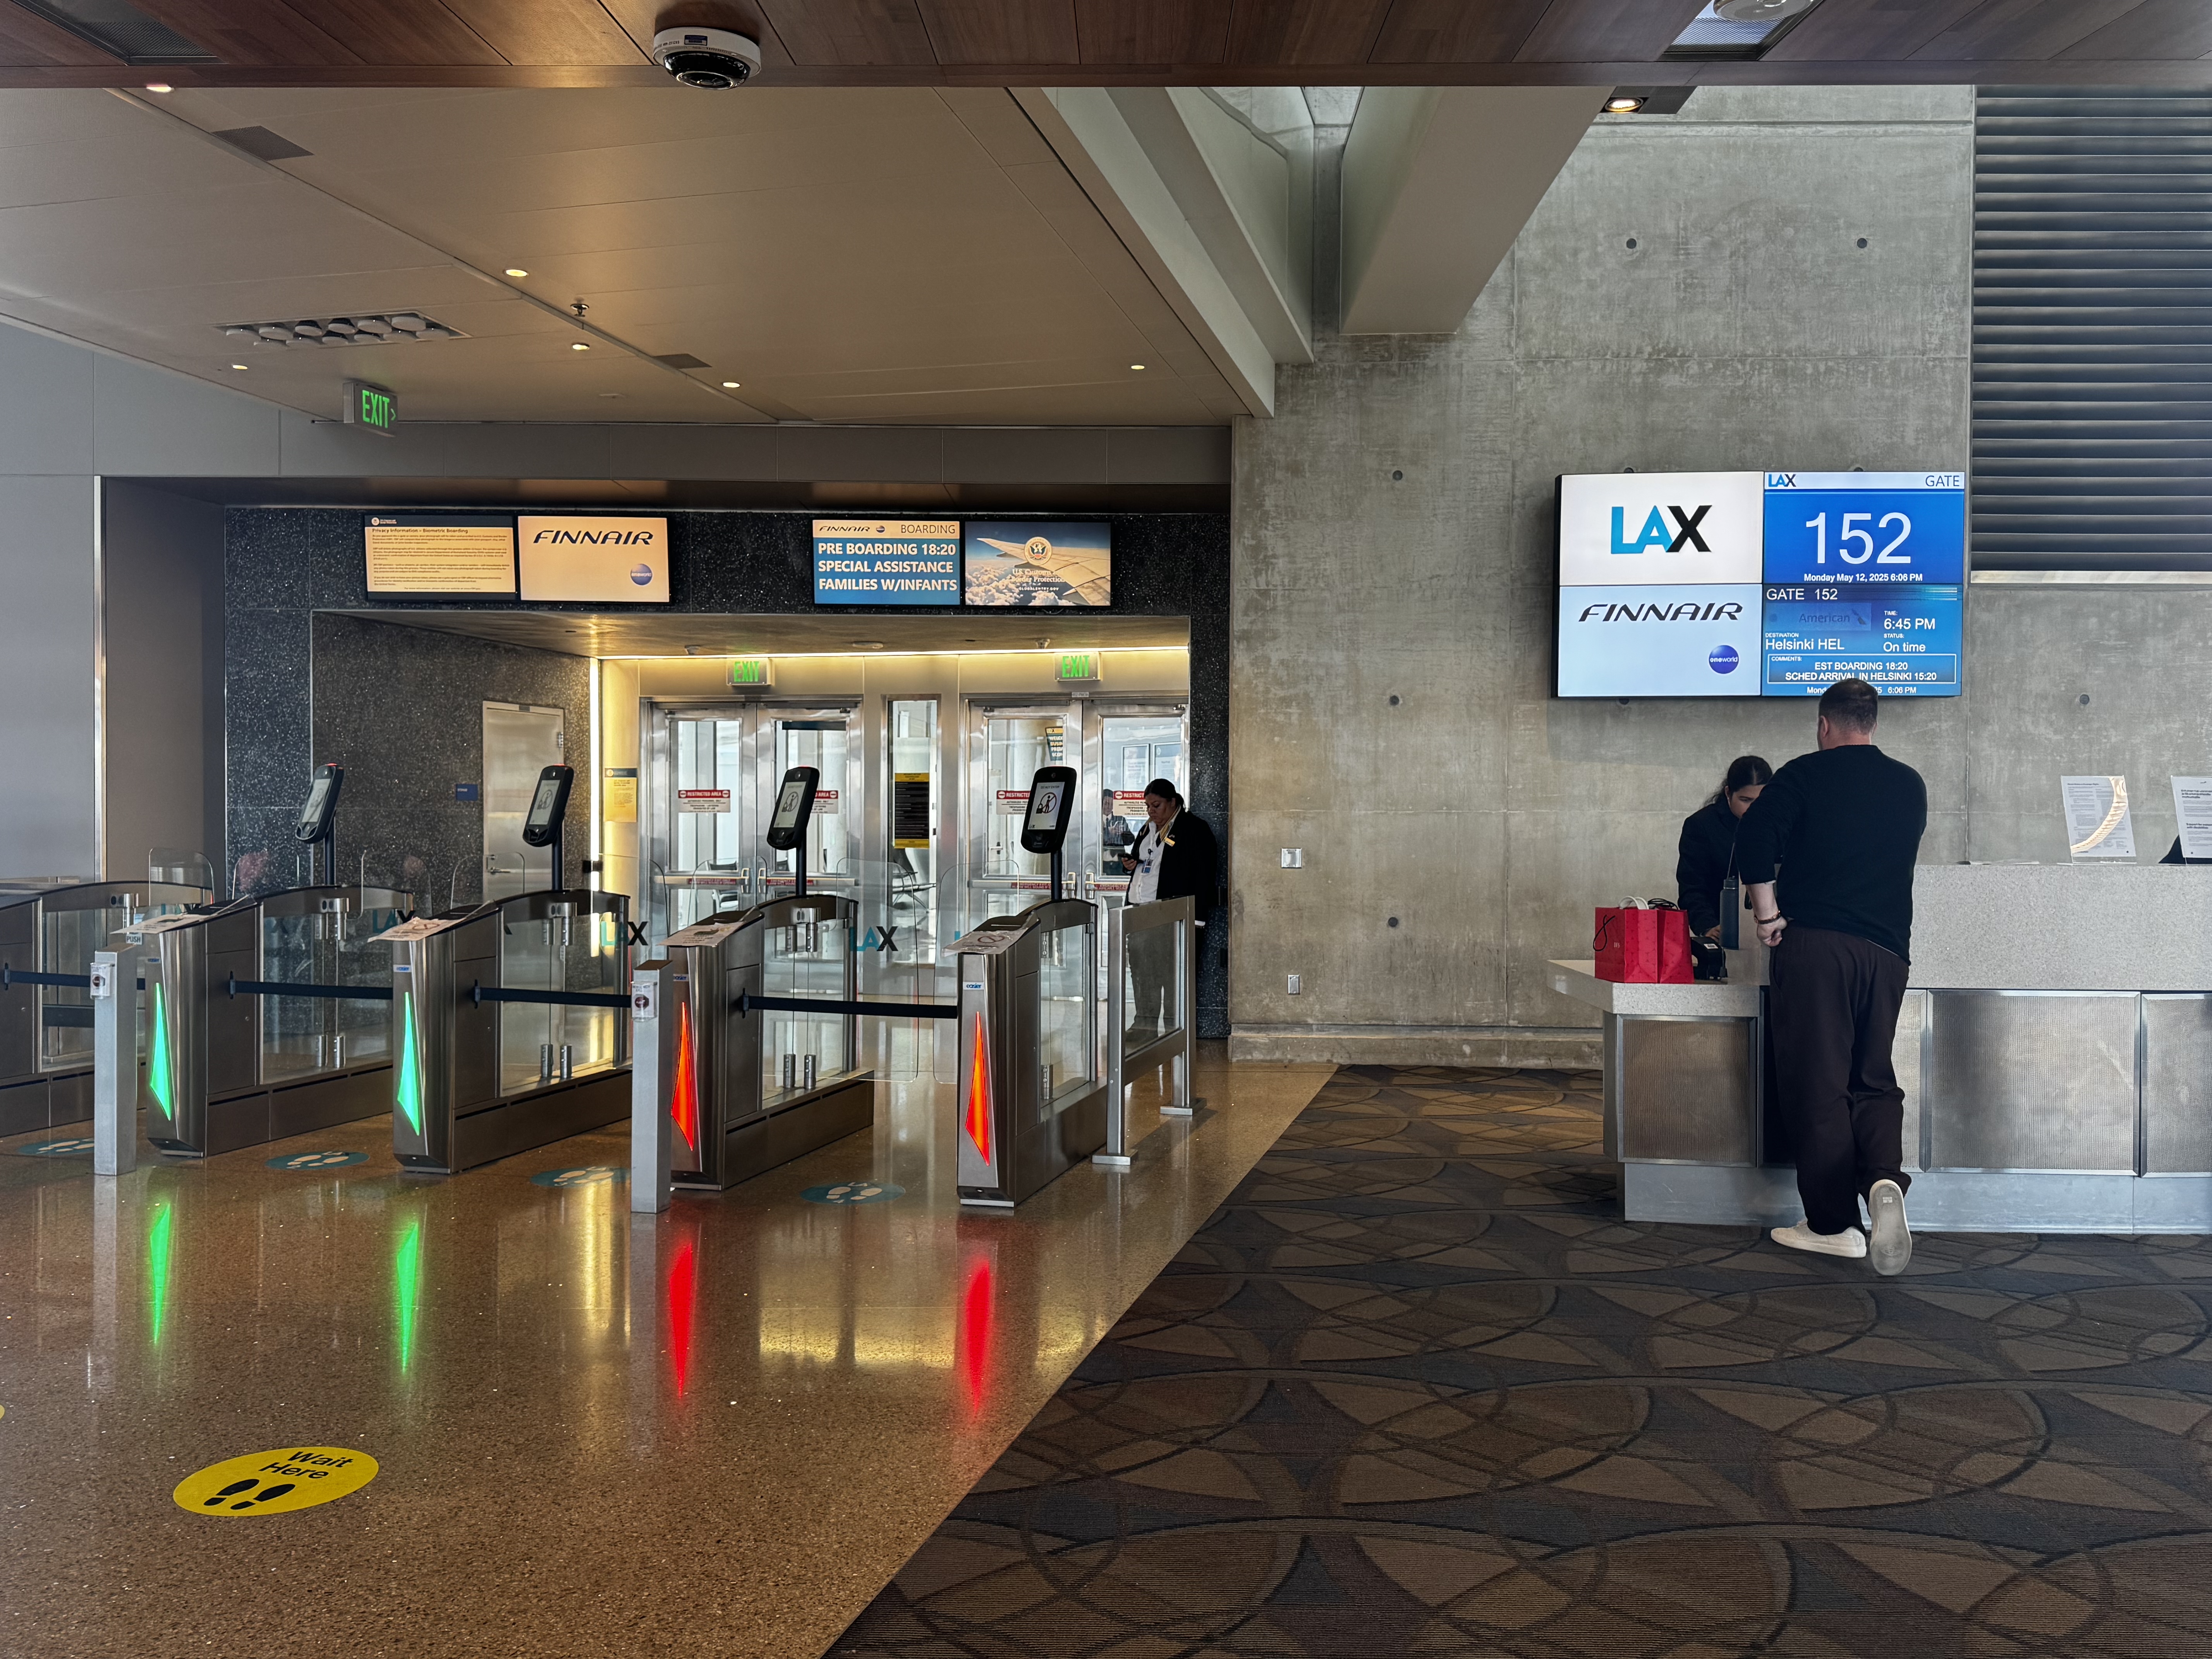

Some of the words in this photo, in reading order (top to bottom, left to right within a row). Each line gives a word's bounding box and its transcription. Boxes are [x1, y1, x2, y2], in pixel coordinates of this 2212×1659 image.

[362, 390, 390, 428] EXIT
[1768, 474, 1796, 487] LAX
[1925, 475, 1960, 487] GATE
[901, 525, 955, 534] BOARDING
[1611, 505, 1712, 554] LAX
[533, 530, 653, 545] FINNAIR
[1806, 512, 1911, 564] 152
[818, 543, 843, 554] PRE
[846, 543, 918, 555] BOARDING
[922, 544, 956, 555] 18:20
[818, 560, 871, 572] SPECIAL
[874, 561, 953, 573] ASSISTANCE
[1804, 574, 1835, 582] Monday
[1837, 574, 1853, 582] May
[1856, 574, 1867, 582] 12,
[819, 579, 878, 590] FAMILIES
[881, 579, 957, 591] W/INFANTS
[1766, 589, 1805, 600] GATE
[1815, 589, 1838, 600] 152
[1578, 603, 1743, 622] FINNAIR
[1799, 613, 1850, 623] American
[1884, 618, 1911, 630] 6:45
[1915, 618, 1936, 630] PM
[1765, 639, 1814, 650] Helsinki
[1818, 639, 1844, 650] HEL
[1883, 642, 1899, 652] On
[1903, 642, 1925, 652] time
[734, 661, 759, 682] EXIT
[1062, 655, 1089, 677] EXIT
[1815, 662, 1832, 670] EST
[1834, 662, 1883, 670] BOARDING
[1785, 673, 1817, 681] SCHED
[1870, 672, 1911, 681] HELSINKI
[1915, 672, 1936, 680] 15:20
[850, 926, 899, 951] LAX
[287, 1451, 354, 1468] Wait
[258, 1462, 329, 1479] Here
